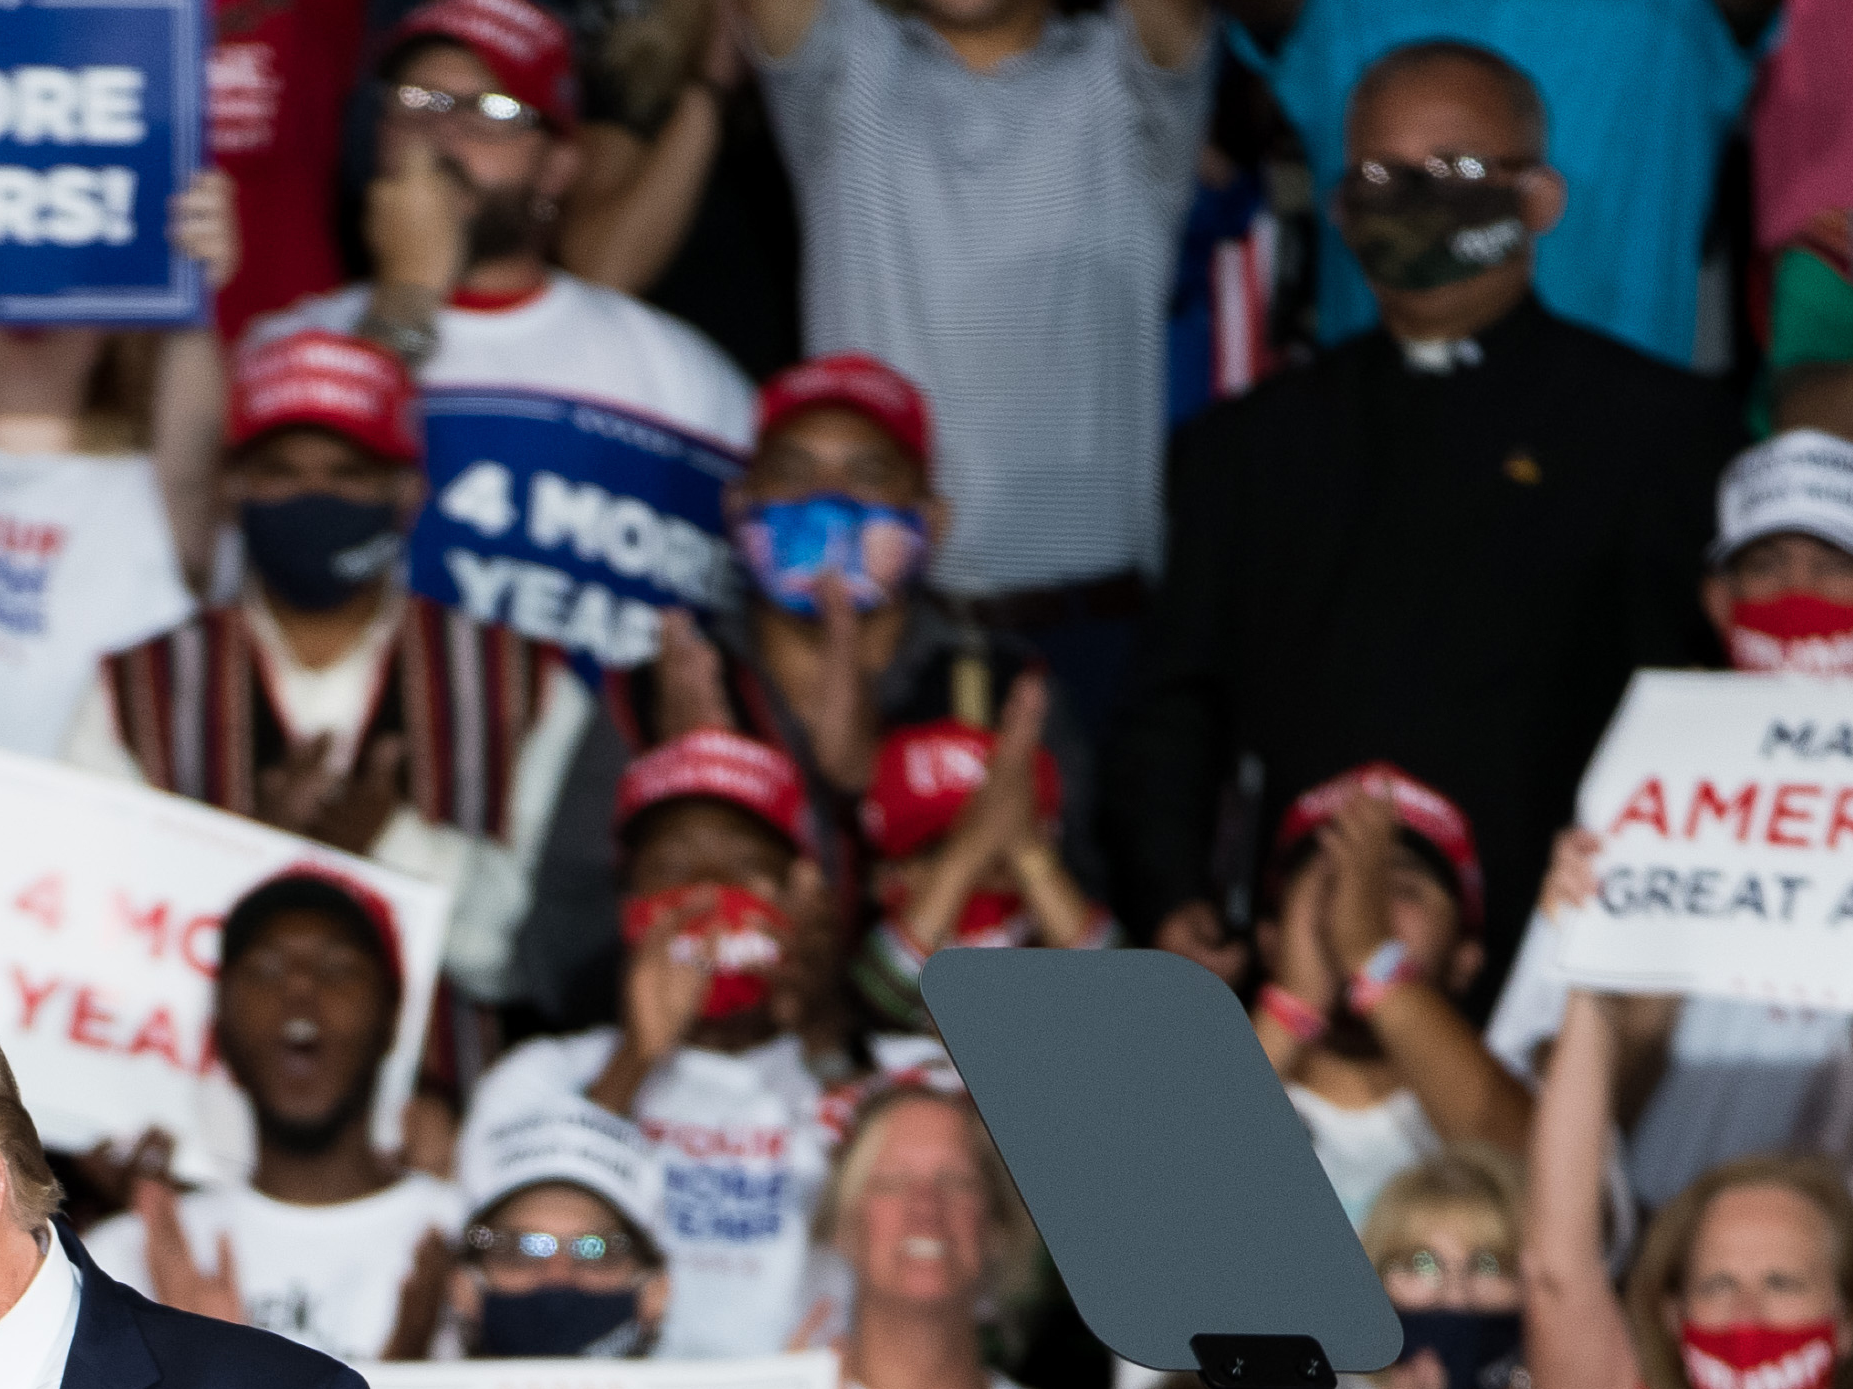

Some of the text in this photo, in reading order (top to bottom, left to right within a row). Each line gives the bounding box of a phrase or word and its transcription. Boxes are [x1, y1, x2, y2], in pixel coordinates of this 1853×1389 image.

[439, 462, 519, 538] 4
[1759, 717, 1853, 764] MA
[1607, 774, 1853, 852] AMER
[14, 870, 225, 980] 4 MO
[1599, 866, 1811, 922] GREAT
[7, 962, 225, 1080] YEA
